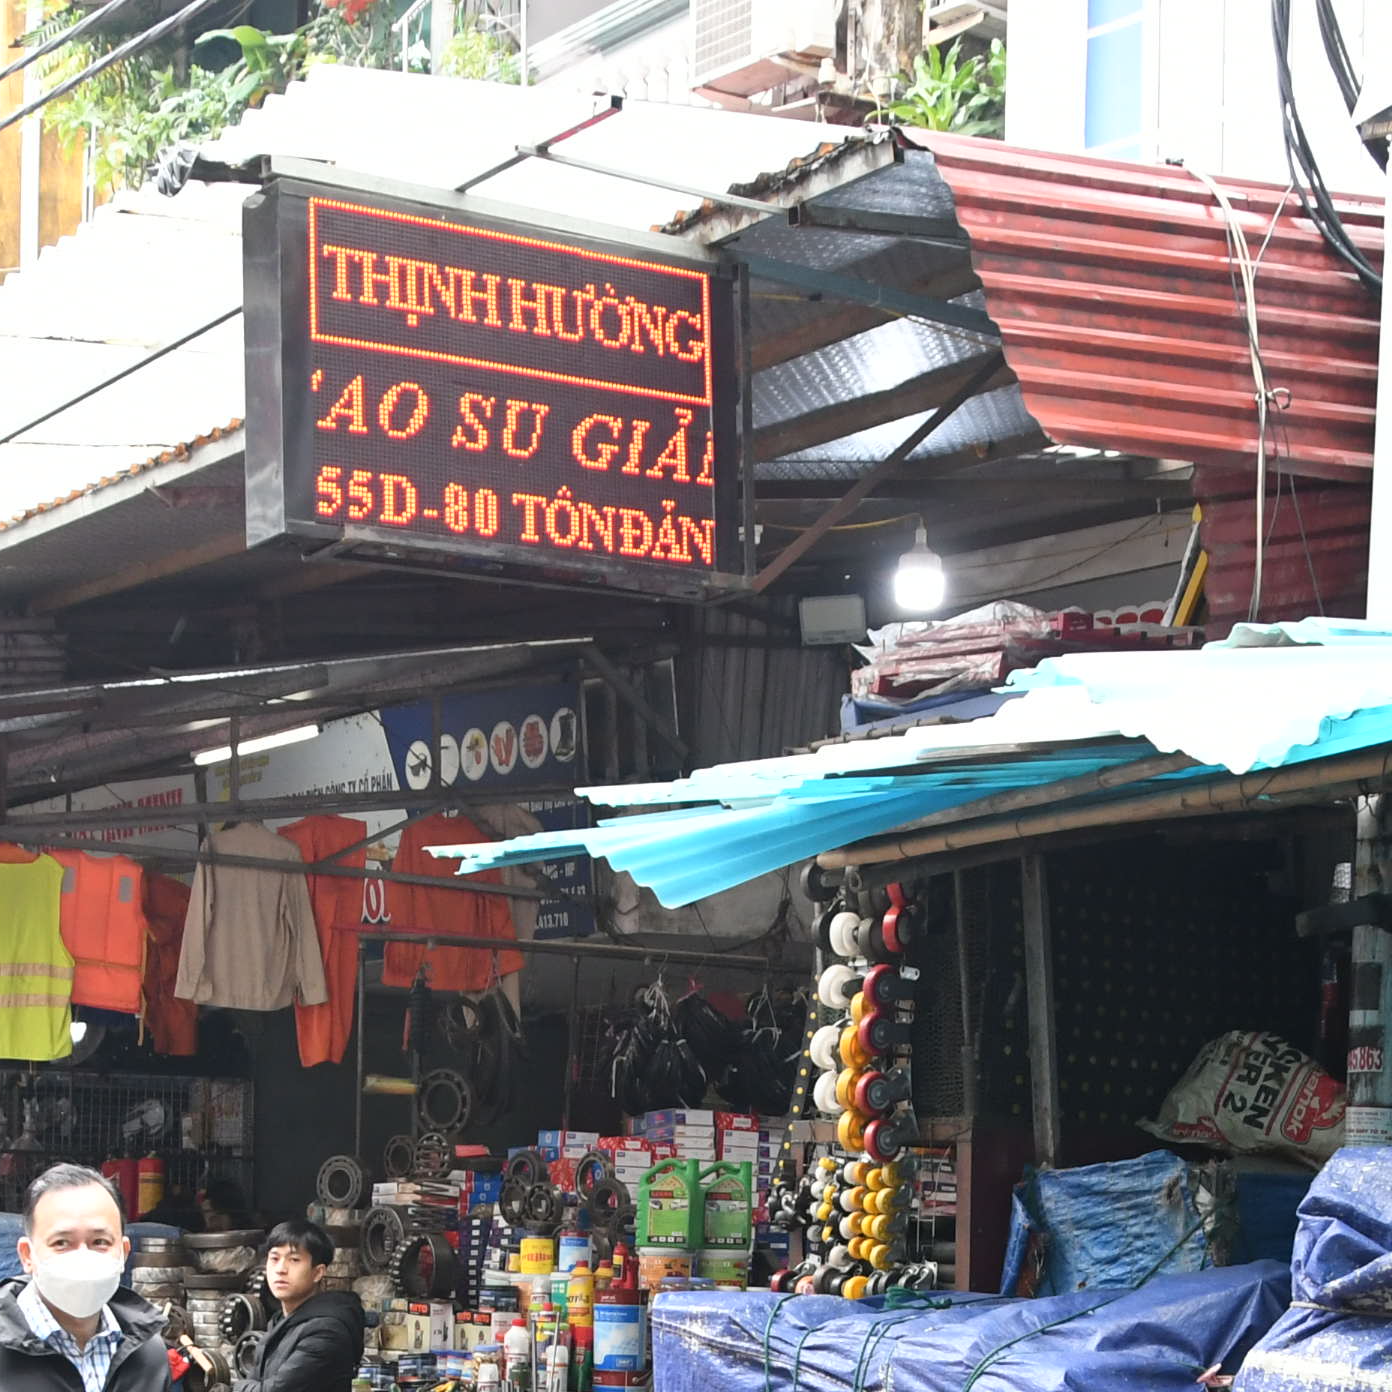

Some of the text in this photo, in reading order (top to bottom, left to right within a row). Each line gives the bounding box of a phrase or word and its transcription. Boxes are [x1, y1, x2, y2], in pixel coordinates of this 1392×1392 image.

[322, 244, 705, 363] THỊNH HƯỜNG
[451, 390, 551, 460] SU
